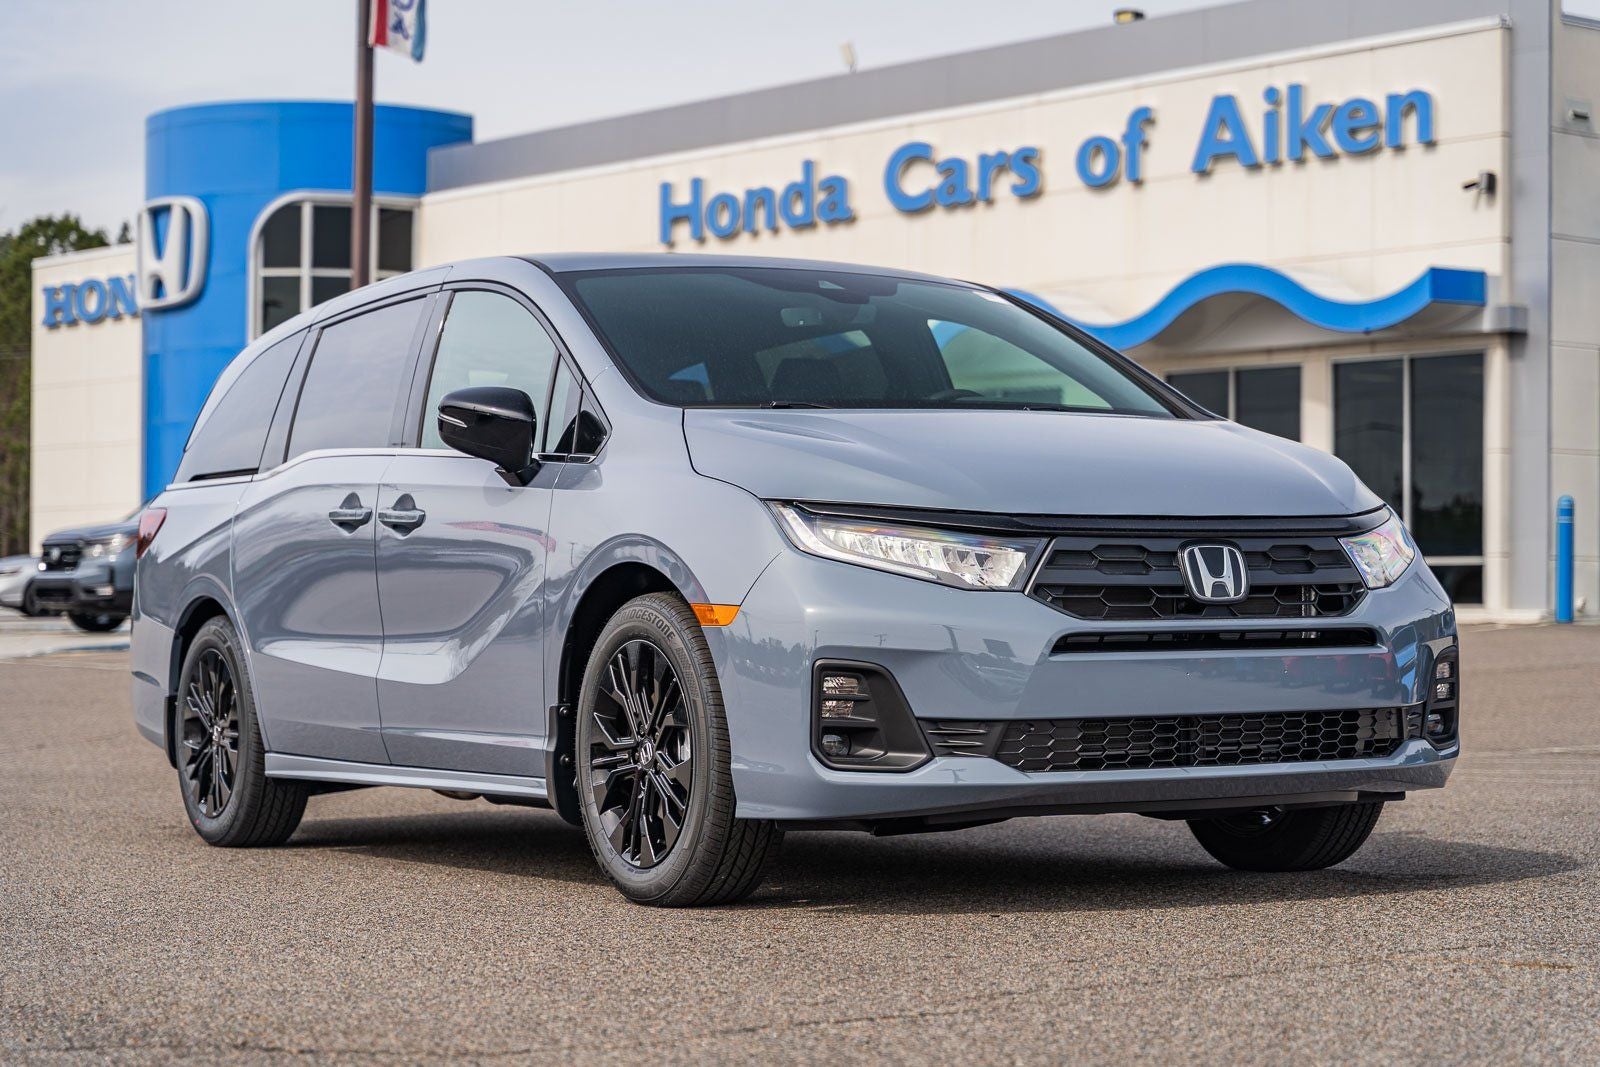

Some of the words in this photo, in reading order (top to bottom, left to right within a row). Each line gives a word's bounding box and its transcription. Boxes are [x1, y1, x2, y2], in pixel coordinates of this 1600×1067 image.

[660, 160, 851, 244] Honda
[883, 142, 1039, 213] Cars
[1076, 106, 1152, 188] of
[1192, 84, 1434, 174] Aiken
